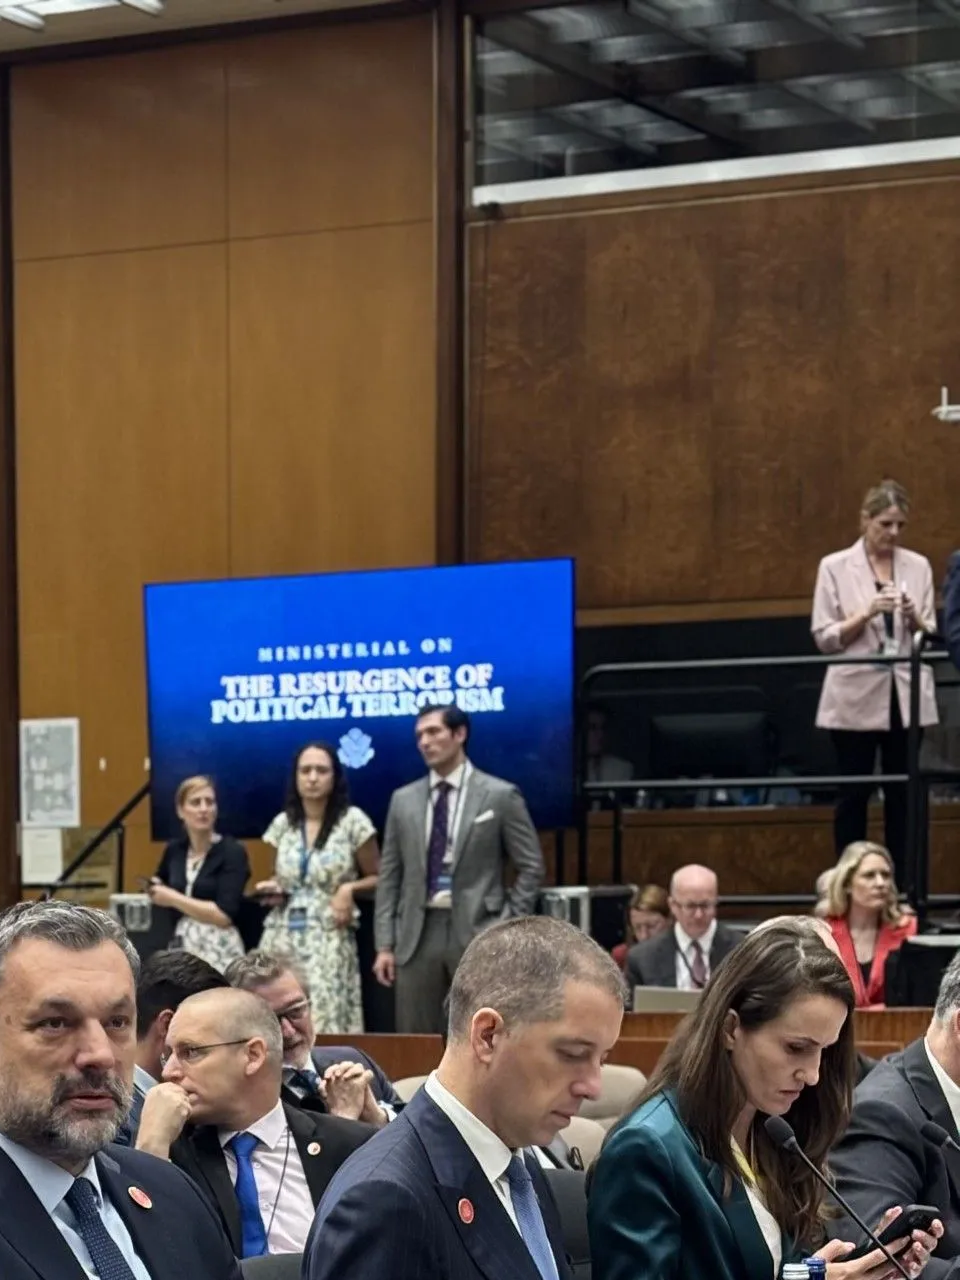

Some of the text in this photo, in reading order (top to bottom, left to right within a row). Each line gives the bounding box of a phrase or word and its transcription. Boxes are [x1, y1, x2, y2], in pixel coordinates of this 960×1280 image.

[258, 637, 453, 663] MINISTERIAL ON
[220, 663, 494, 699] THE RESURGENCE OF
[210, 693, 347, 724] POLITICAL
